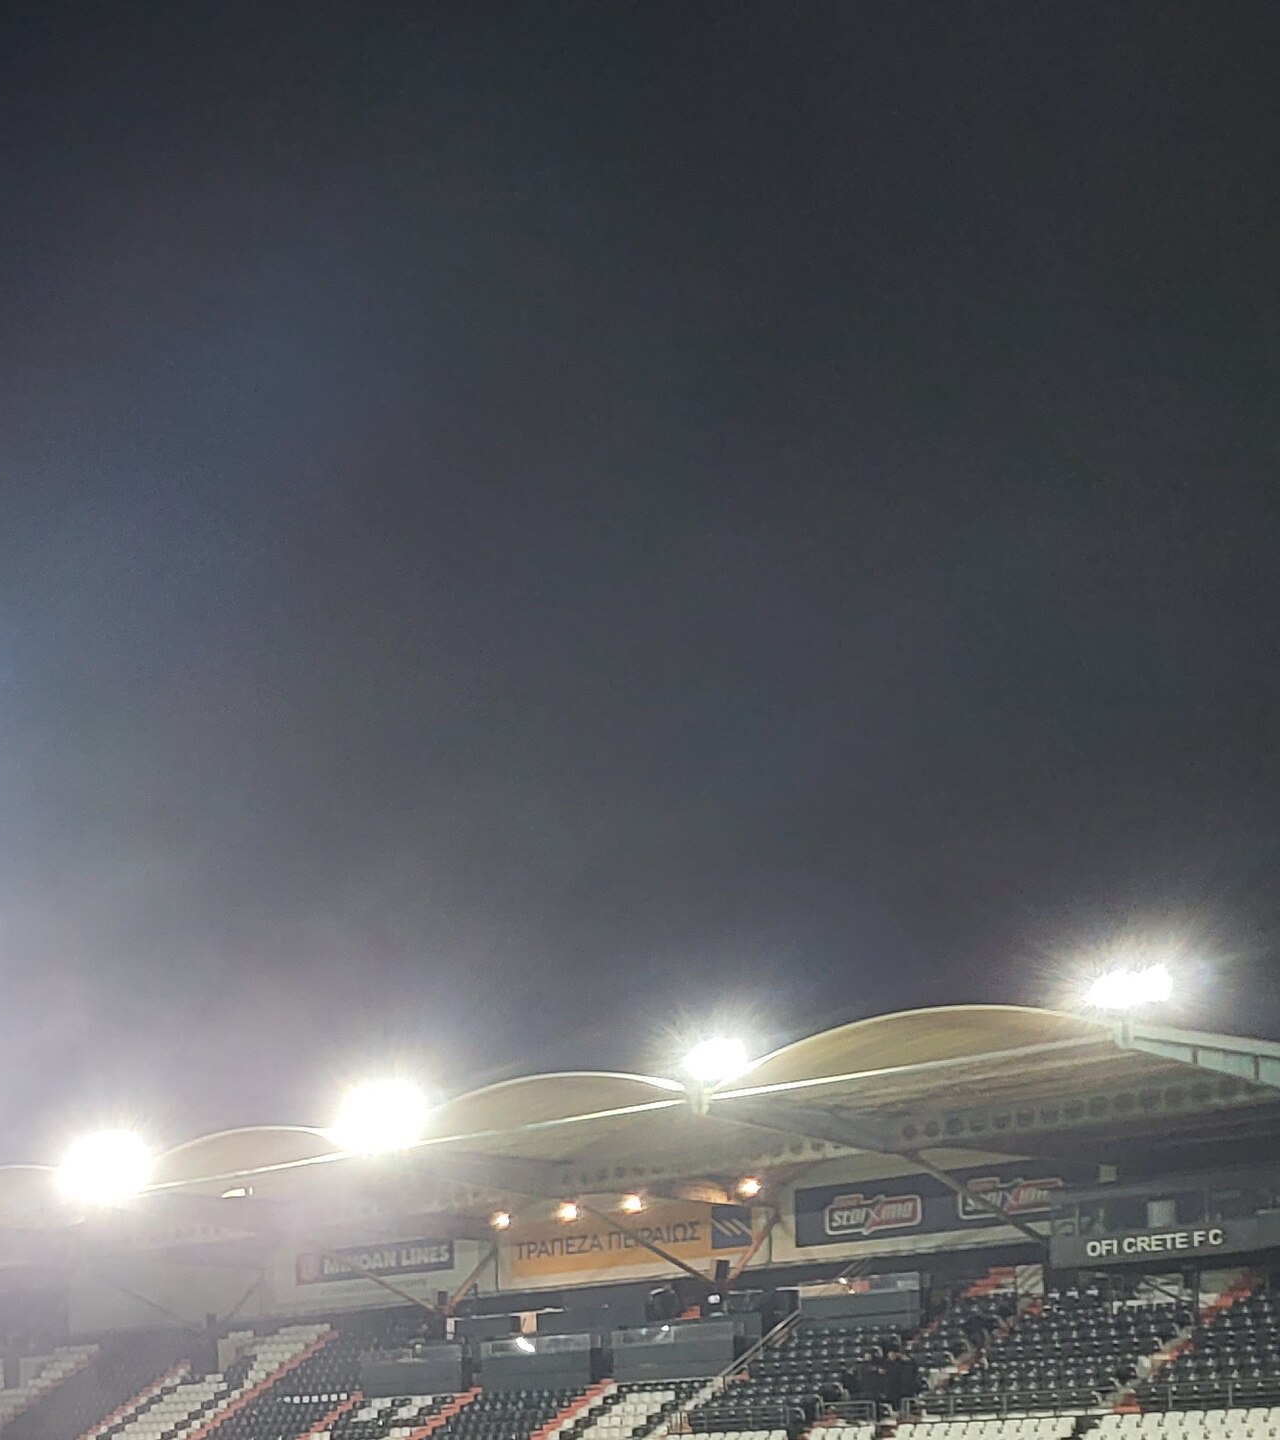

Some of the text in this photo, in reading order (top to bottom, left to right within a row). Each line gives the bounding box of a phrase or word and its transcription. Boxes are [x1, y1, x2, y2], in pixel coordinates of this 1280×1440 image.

[515, 1234, 603, 1260] ΤΡΑΠΕΖΑ
[1086, 1240, 1119, 1258] OFI
[1123, 1234, 1188, 1255] CRETE
